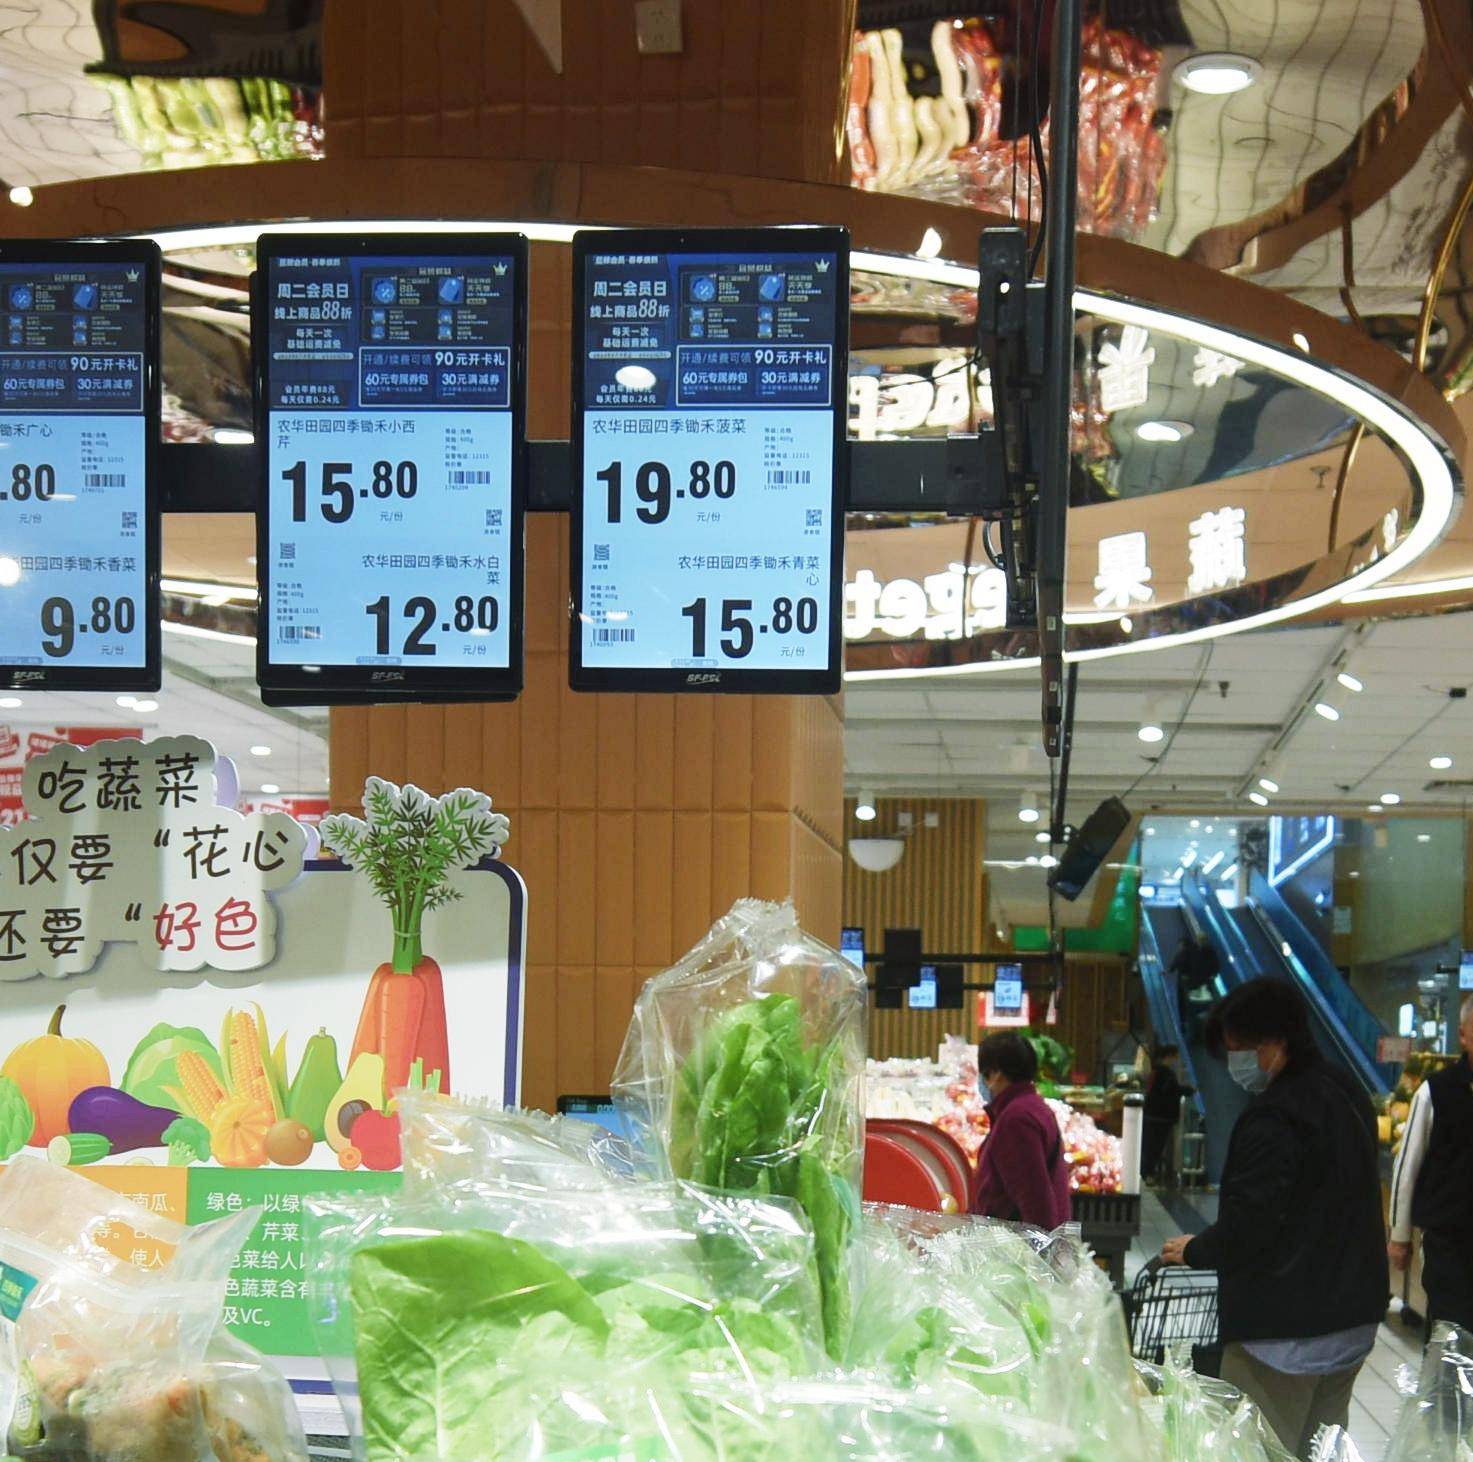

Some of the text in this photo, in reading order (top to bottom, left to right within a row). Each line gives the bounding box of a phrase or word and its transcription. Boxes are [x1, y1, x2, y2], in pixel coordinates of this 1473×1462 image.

[277, 283, 349, 299] 周二会员日
[594, 280, 666, 297] 周二会员日
[274, 301, 352, 320] 线上商品88折
[590, 299, 670, 318] 线上商品88折
[612, 326, 649, 337] 每天一次
[71, 357, 138, 371] 90元开卡礼
[435, 352, 505, 366] 90元开卡礼
[755, 350, 827, 364] 90元开卡礼
[365, 373, 428, 386] 60元专属券包
[442, 373, 500, 386] 30元满减券
[683, 372, 748, 384] 60元专属券包
[761, 372, 821, 384] 30元满减券
[278, 419, 415, 434] 农华田园四季锄禾小西
[592, 419, 746, 434] 农华田园四季锄禾菠菜
[277, 435, 290, 449] 芹
[282, 460, 418, 524] 15.80
[597, 461, 736, 524] 19.80
[697, 512, 720, 523] 元/份
[362, 555, 500, 569] 农华田园四季锄禾水白
[678, 556, 820, 570] 农华田园四季锄禾青菜
[487, 571, 500, 585] 菜
[806, 573, 819, 585] 心
[41, 597, 135, 658] 9.80
[366, 595, 499, 656] 12.80
[682, 597, 818, 658] 15.80
[781, 646, 804, 657] 元/份
[38, 752, 200, 814] 吃蔬菜
